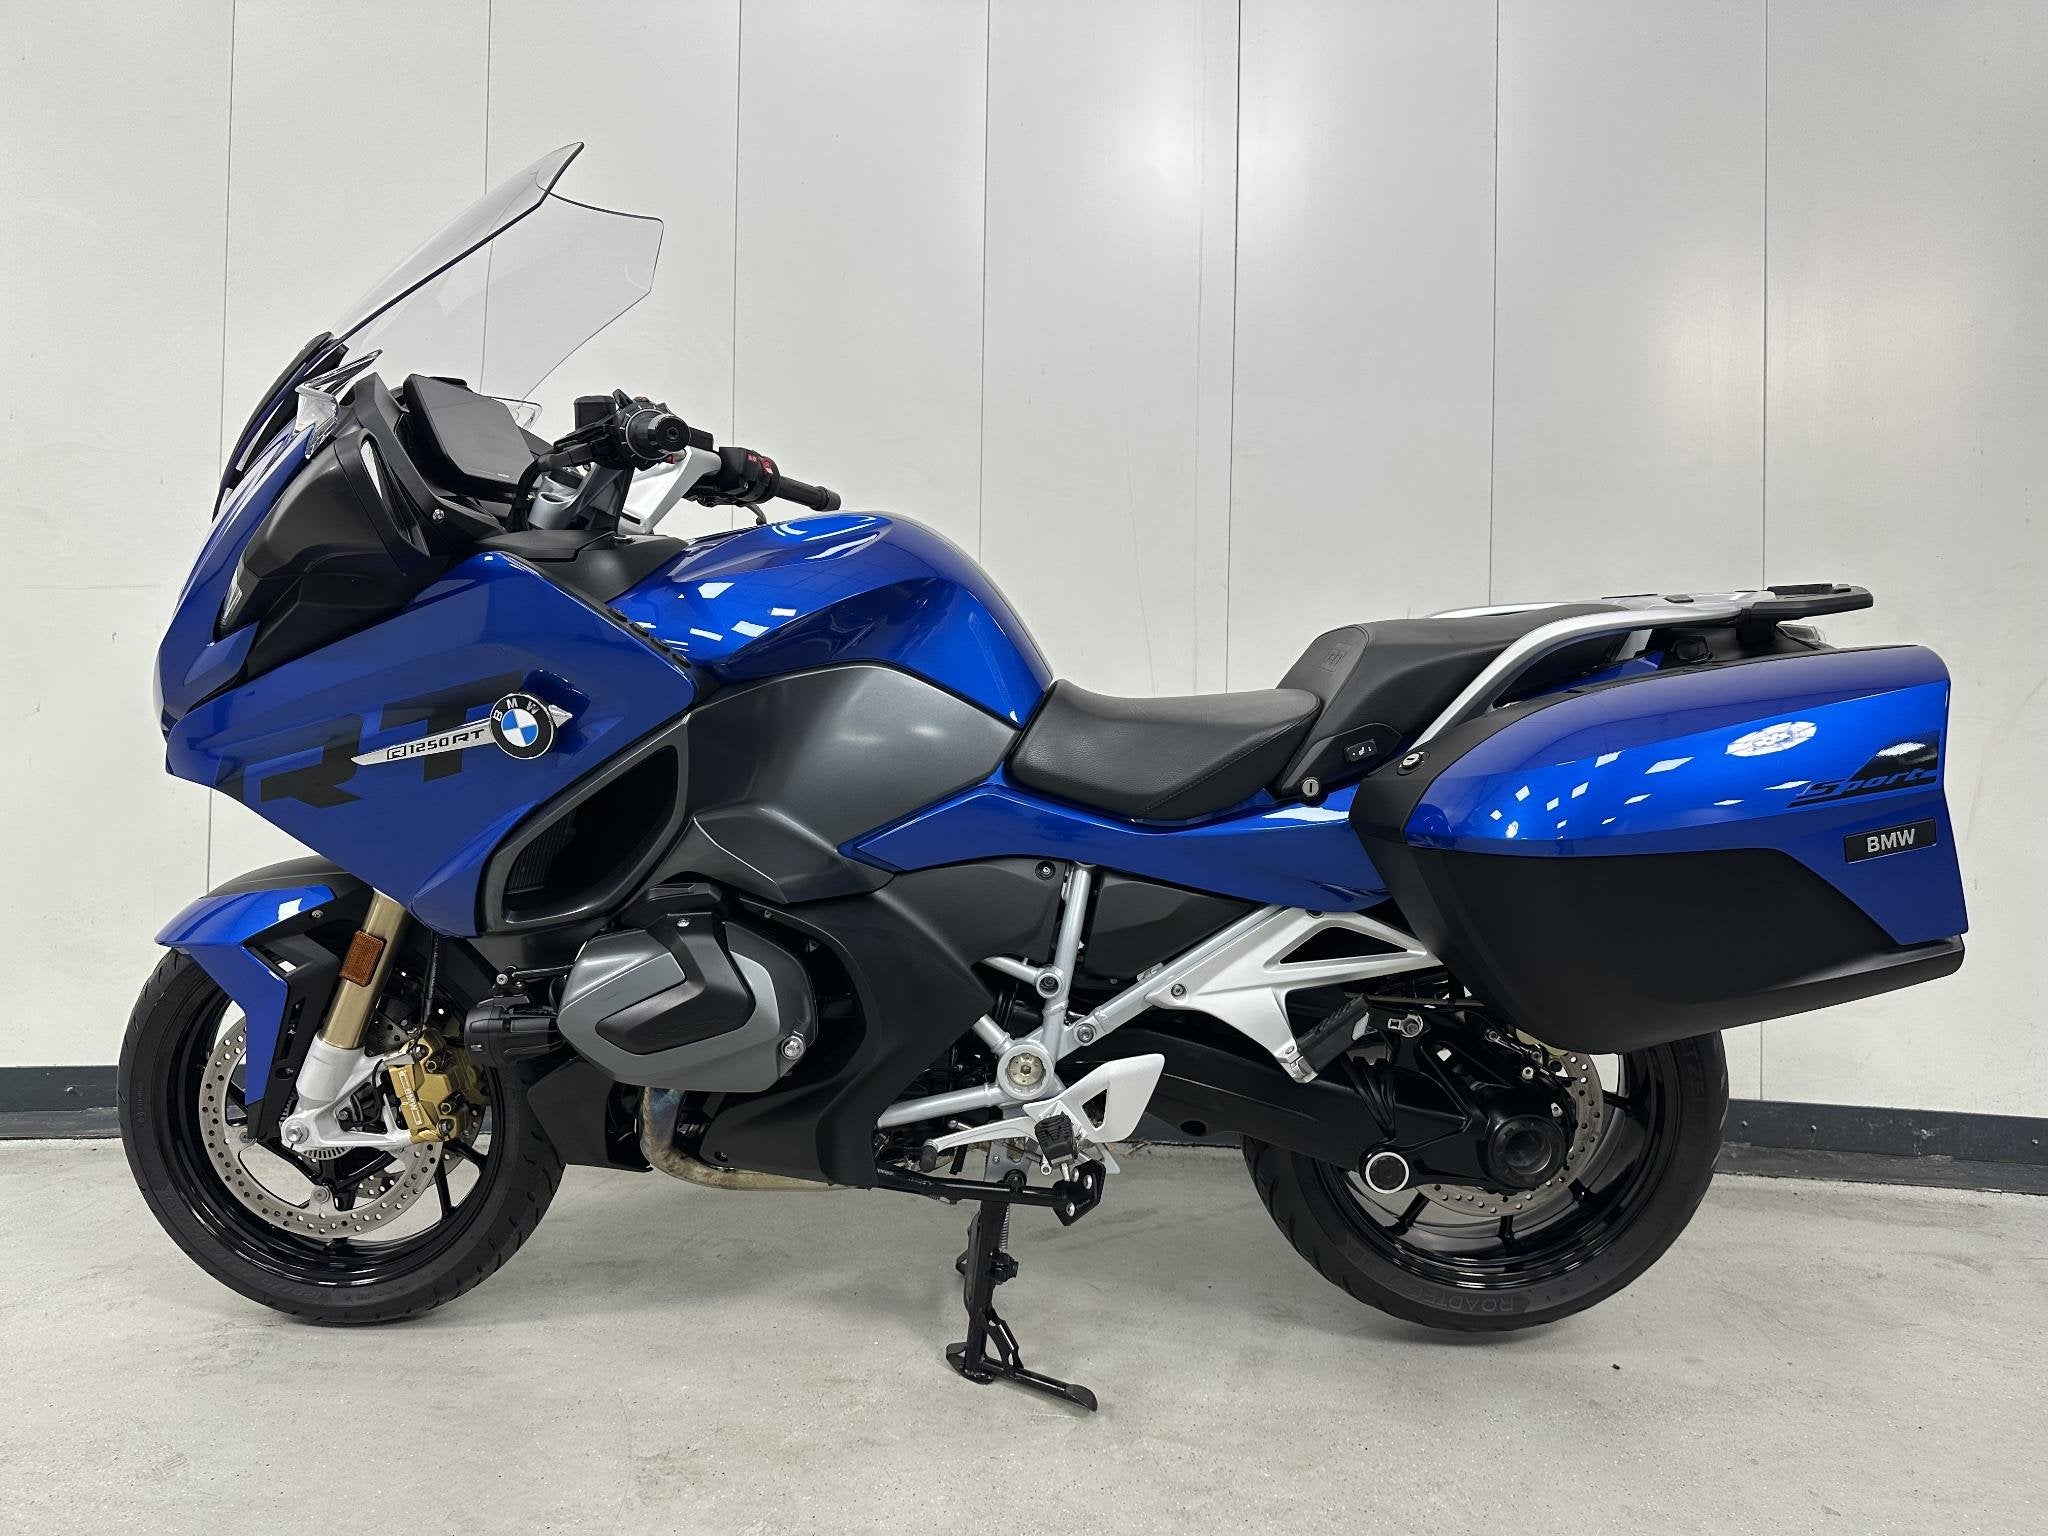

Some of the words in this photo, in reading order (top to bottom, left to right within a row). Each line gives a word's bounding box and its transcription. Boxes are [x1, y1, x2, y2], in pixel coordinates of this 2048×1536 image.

[493, 698, 540, 721] BMW
[1796, 768, 1937, 798] Sport
[1866, 828, 1915, 853] BMW
